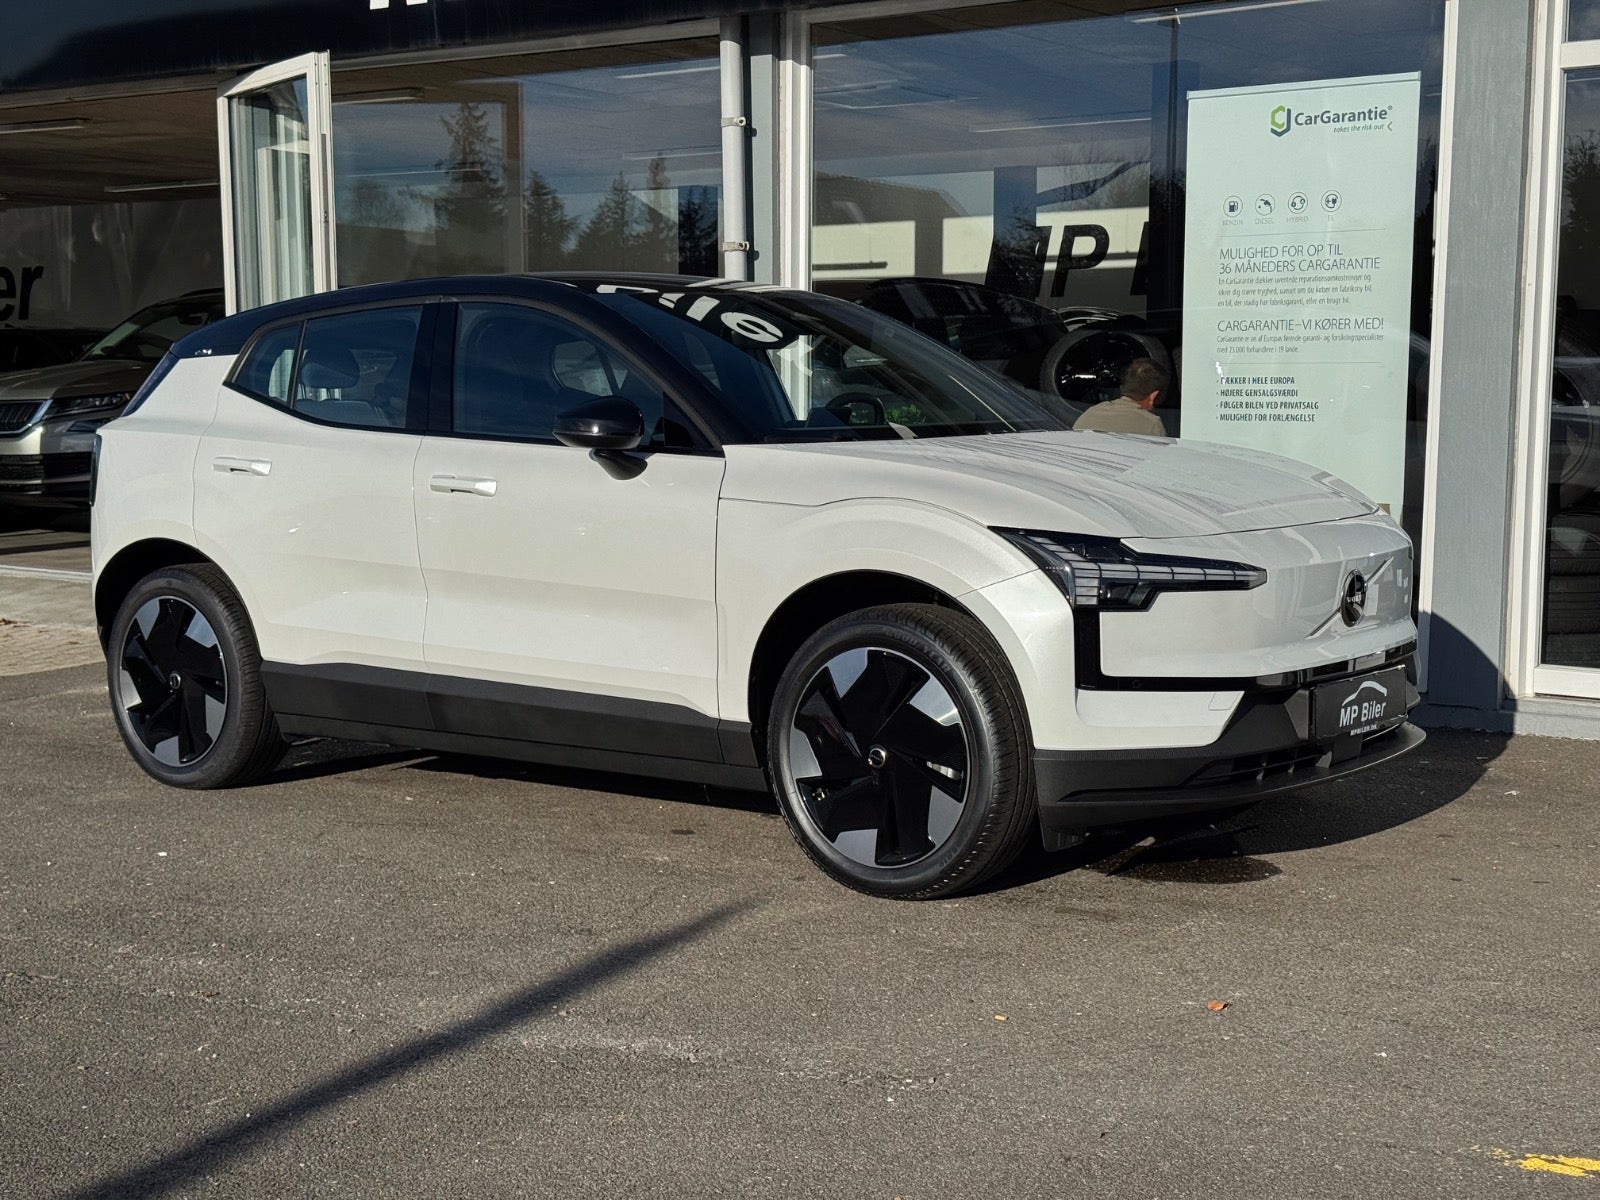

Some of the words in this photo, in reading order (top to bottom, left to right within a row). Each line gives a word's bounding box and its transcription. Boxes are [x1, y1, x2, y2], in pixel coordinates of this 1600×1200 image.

[1219, 247, 1279, 259] MULIGHED
[1282, 245, 1304, 257] FOR
[1307, 244, 1324, 256] OP
[1327, 244, 1343, 255] TIL
[1219, 263, 1231, 274] 36
[1235, 259, 1295, 273] MÅNEDERS
[1298, 257, 1381, 271] CARGARANTIE
[1315, 318, 1351, 330] KØRER
[1354, 317, 1384, 329] MED!
[1220, 389, 1243, 397] HØJERE
[1245, 389, 1298, 397] GENSALGSVÆRDI
[1220, 401, 1244, 409] FØLGER
[1280, 401, 1319, 409] PRIVATSALG
[1269, 414, 1315, 422] FORLÆNGELSE
[1339, 705, 1358, 728] MP
[1361, 700, 1387, 722] Biler
